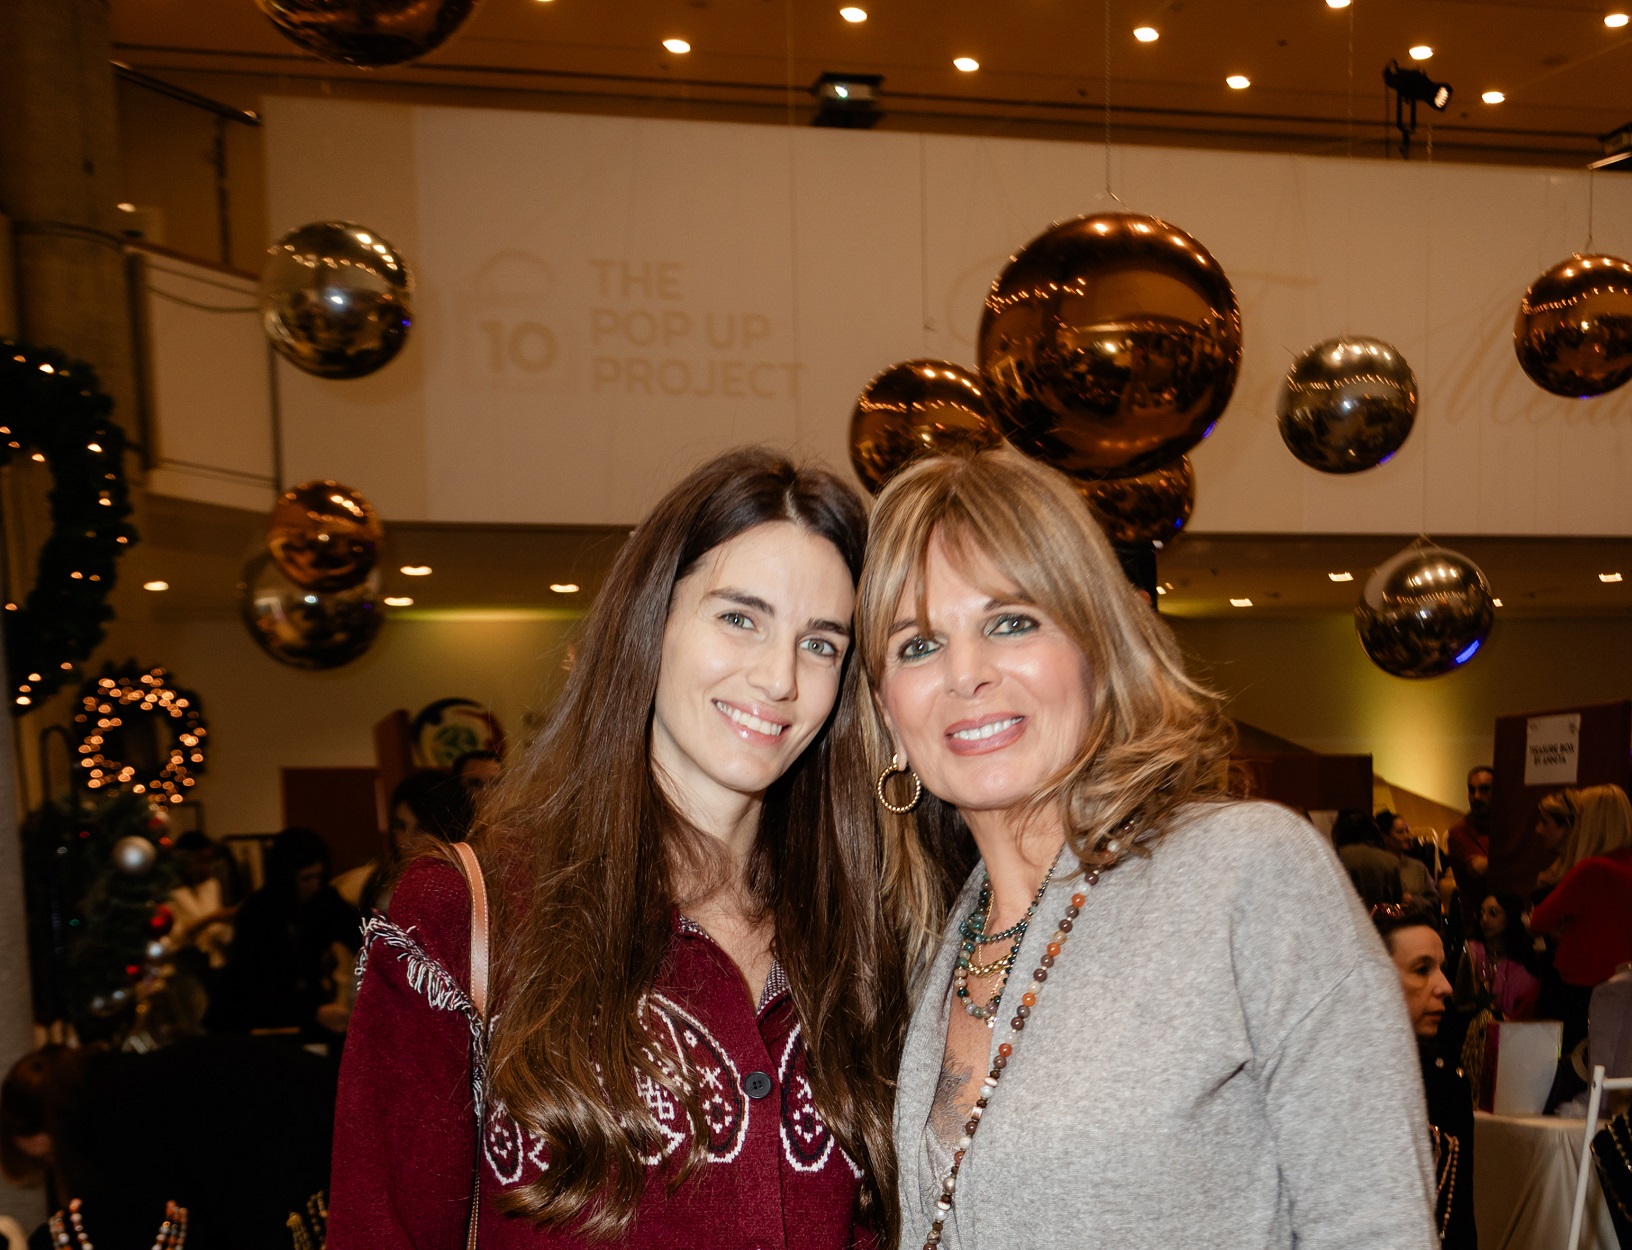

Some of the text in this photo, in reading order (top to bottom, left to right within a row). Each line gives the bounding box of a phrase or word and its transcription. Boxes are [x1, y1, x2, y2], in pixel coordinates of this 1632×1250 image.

[589, 258, 684, 300] THE
[479, 319, 559, 374] 10
[591, 307, 772, 350] POP UP
[593, 355, 805, 398] PROJECT
